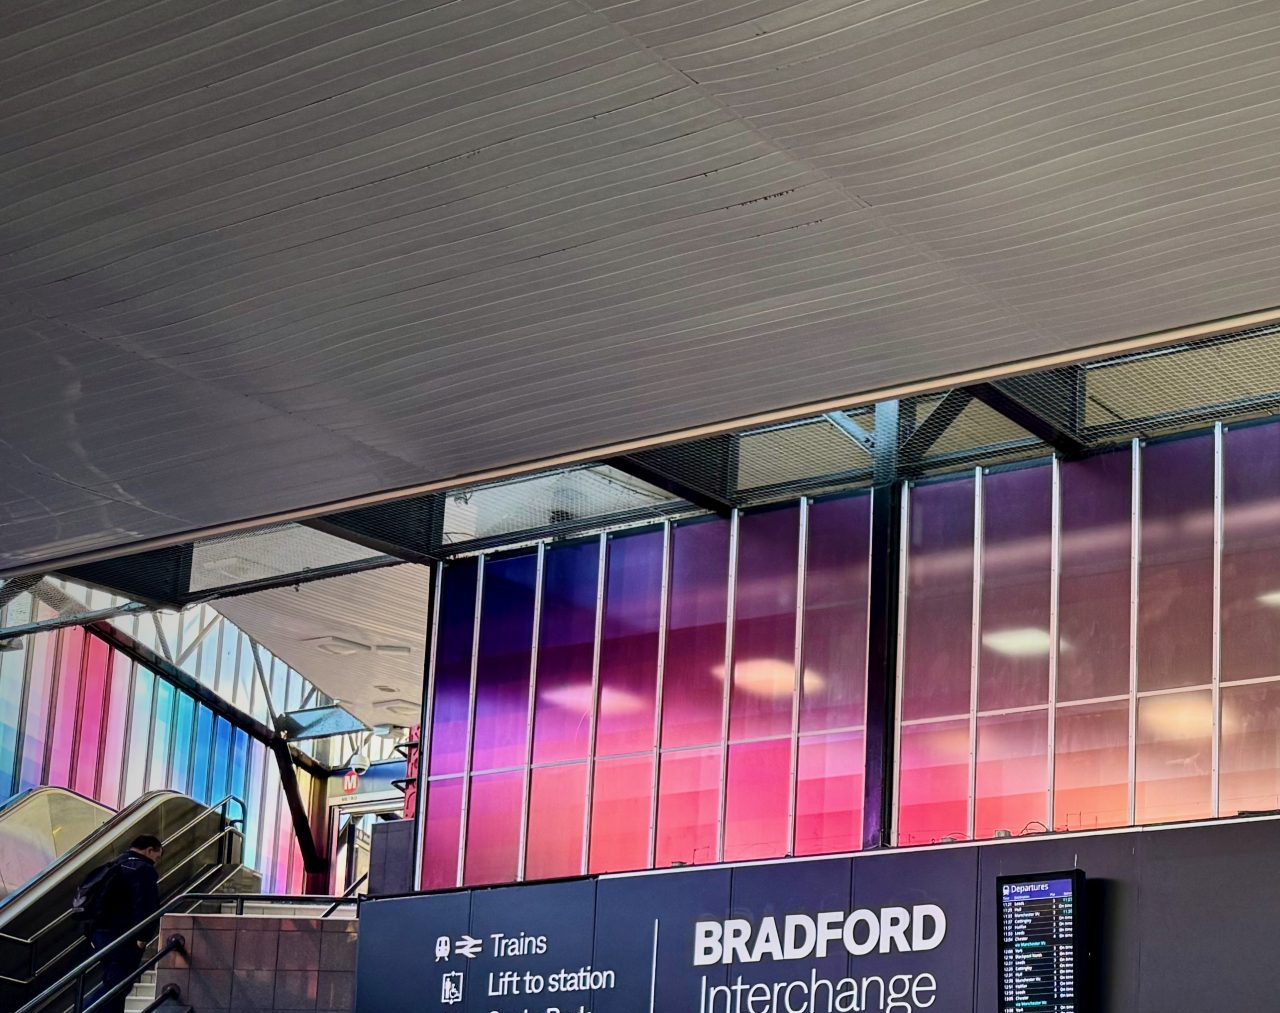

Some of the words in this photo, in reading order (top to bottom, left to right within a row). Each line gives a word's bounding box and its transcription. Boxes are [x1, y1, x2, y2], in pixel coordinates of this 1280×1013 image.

[1011, 883, 1049, 894] Departures
[490, 931, 547, 957] Trains
[693, 903, 947, 966] BRADFORD
[488, 971, 520, 996] Lift
[524, 974, 545, 993] to
[548, 965, 615, 992] station
